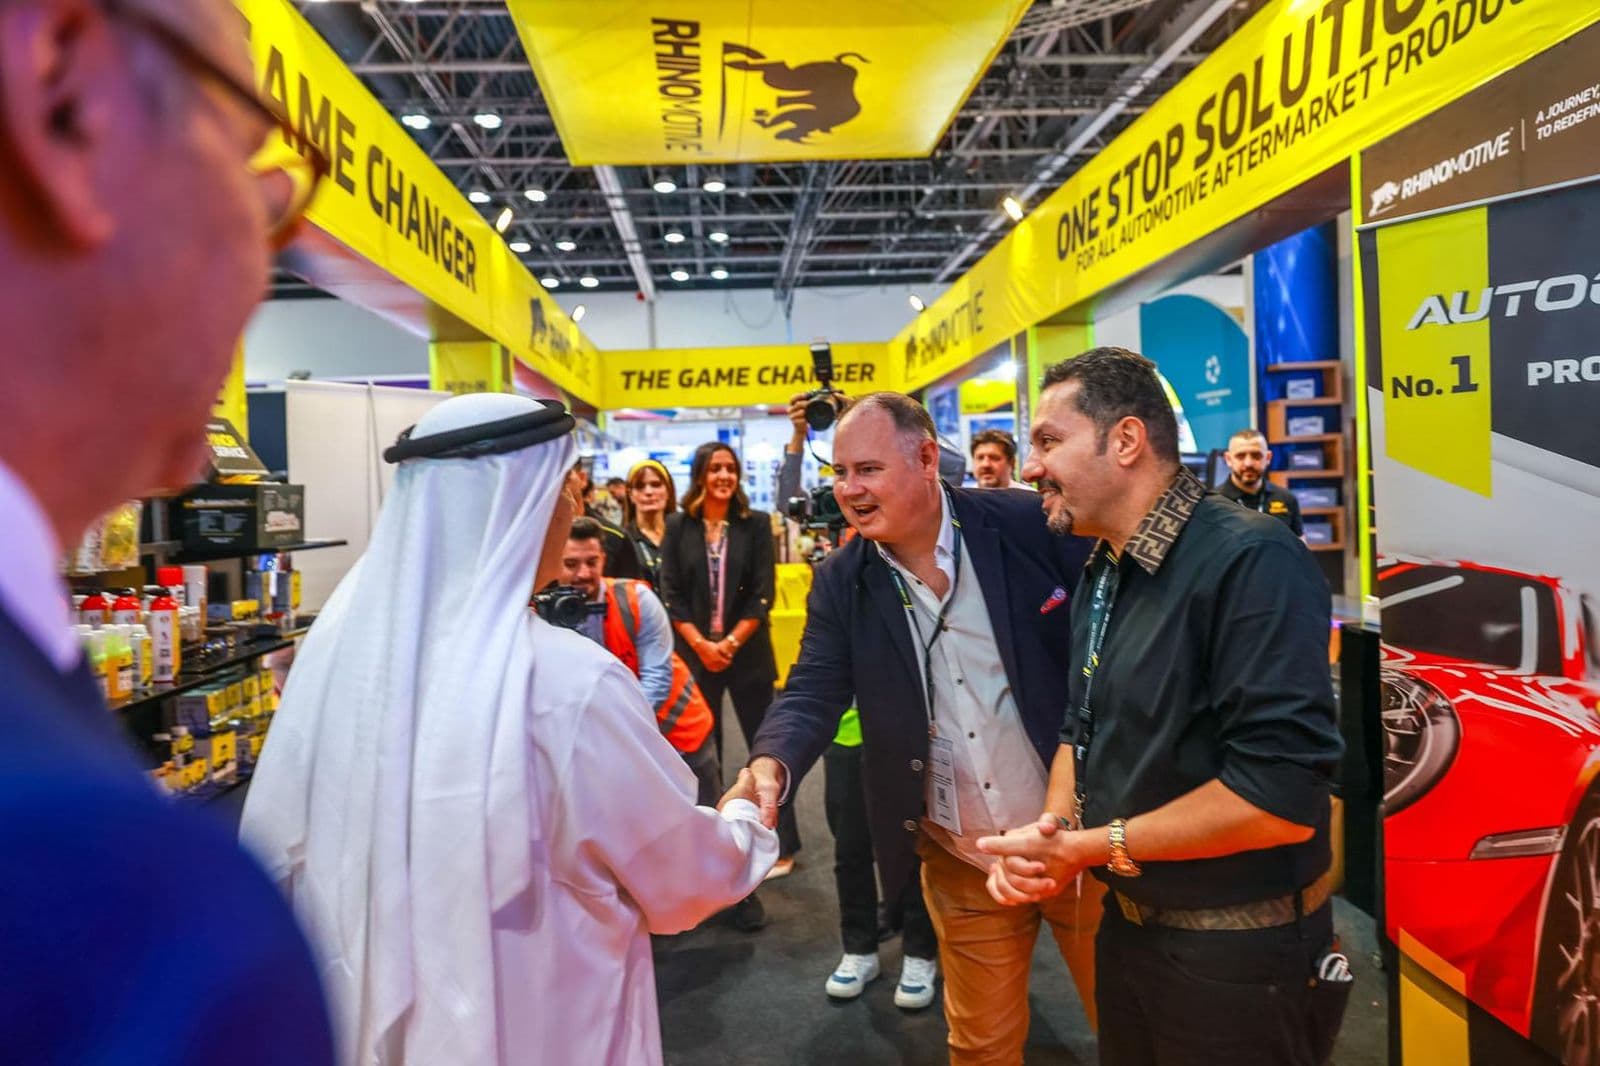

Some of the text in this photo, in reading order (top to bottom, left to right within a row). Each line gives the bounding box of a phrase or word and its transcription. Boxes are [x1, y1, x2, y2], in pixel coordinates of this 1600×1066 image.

[651, 17, 703, 151] RHINOMOTIVE
[1057, 0, 1443, 262] ONE STOP SOLUTI
[1075, 0, 1526, 273] FOR ALL AUTOMOTIVE AFTERMARKET PRODU
[1535, 110, 1545, 124] A
[1536, 124, 1552, 140] TO
[259, 45, 477, 293] AME CHANGER
[1401, 130, 1511, 200] RHINOMOTIVE
[1405, 273, 1600, 331] AUTO
[621, 369, 671, 391] THE
[678, 366, 751, 389] GAME
[1391, 355, 1480, 399] No. 1
[1527, 355, 1600, 386] PRO
